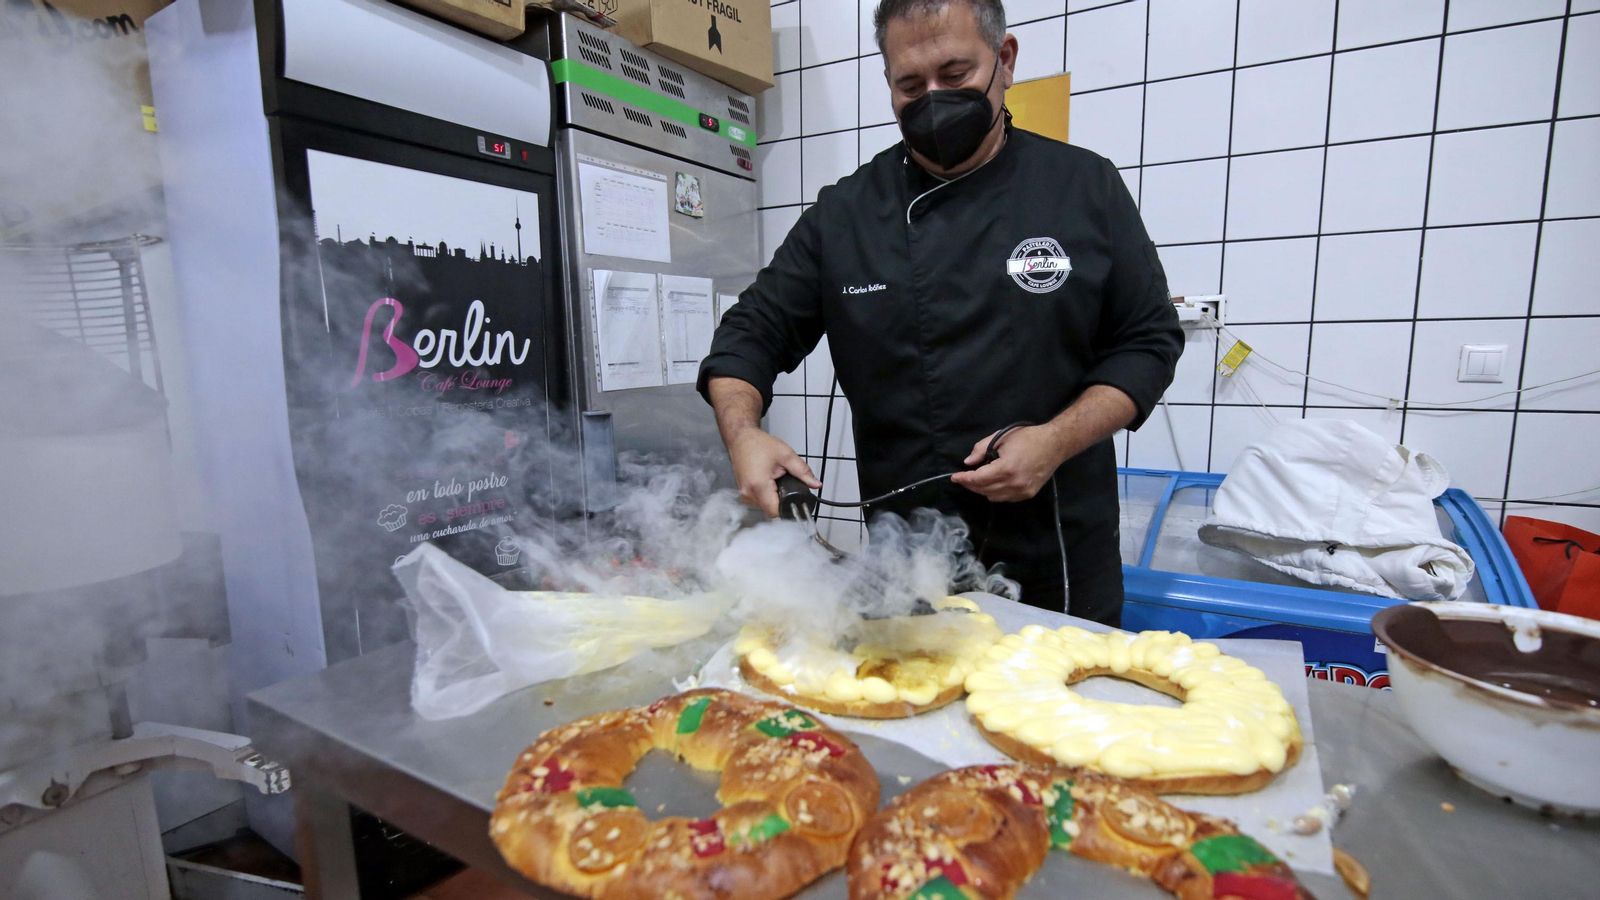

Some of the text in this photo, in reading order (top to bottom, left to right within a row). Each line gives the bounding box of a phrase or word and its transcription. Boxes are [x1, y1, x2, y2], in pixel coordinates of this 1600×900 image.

[707, 0, 742, 23] FRAGIL
[1022, 257, 1058, 272] Berlin
[848, 286, 868, 294] Carlos
[350, 297, 531, 389] Berlin
[416, 369, 513, 395] Café Lounge
[406, 471, 509, 504] en todo postre
[418, 498, 507, 525] es siempre
[409, 533, 431, 544] una
[432, 519, 477, 539] cucharada
[479, 516, 490, 529] de
